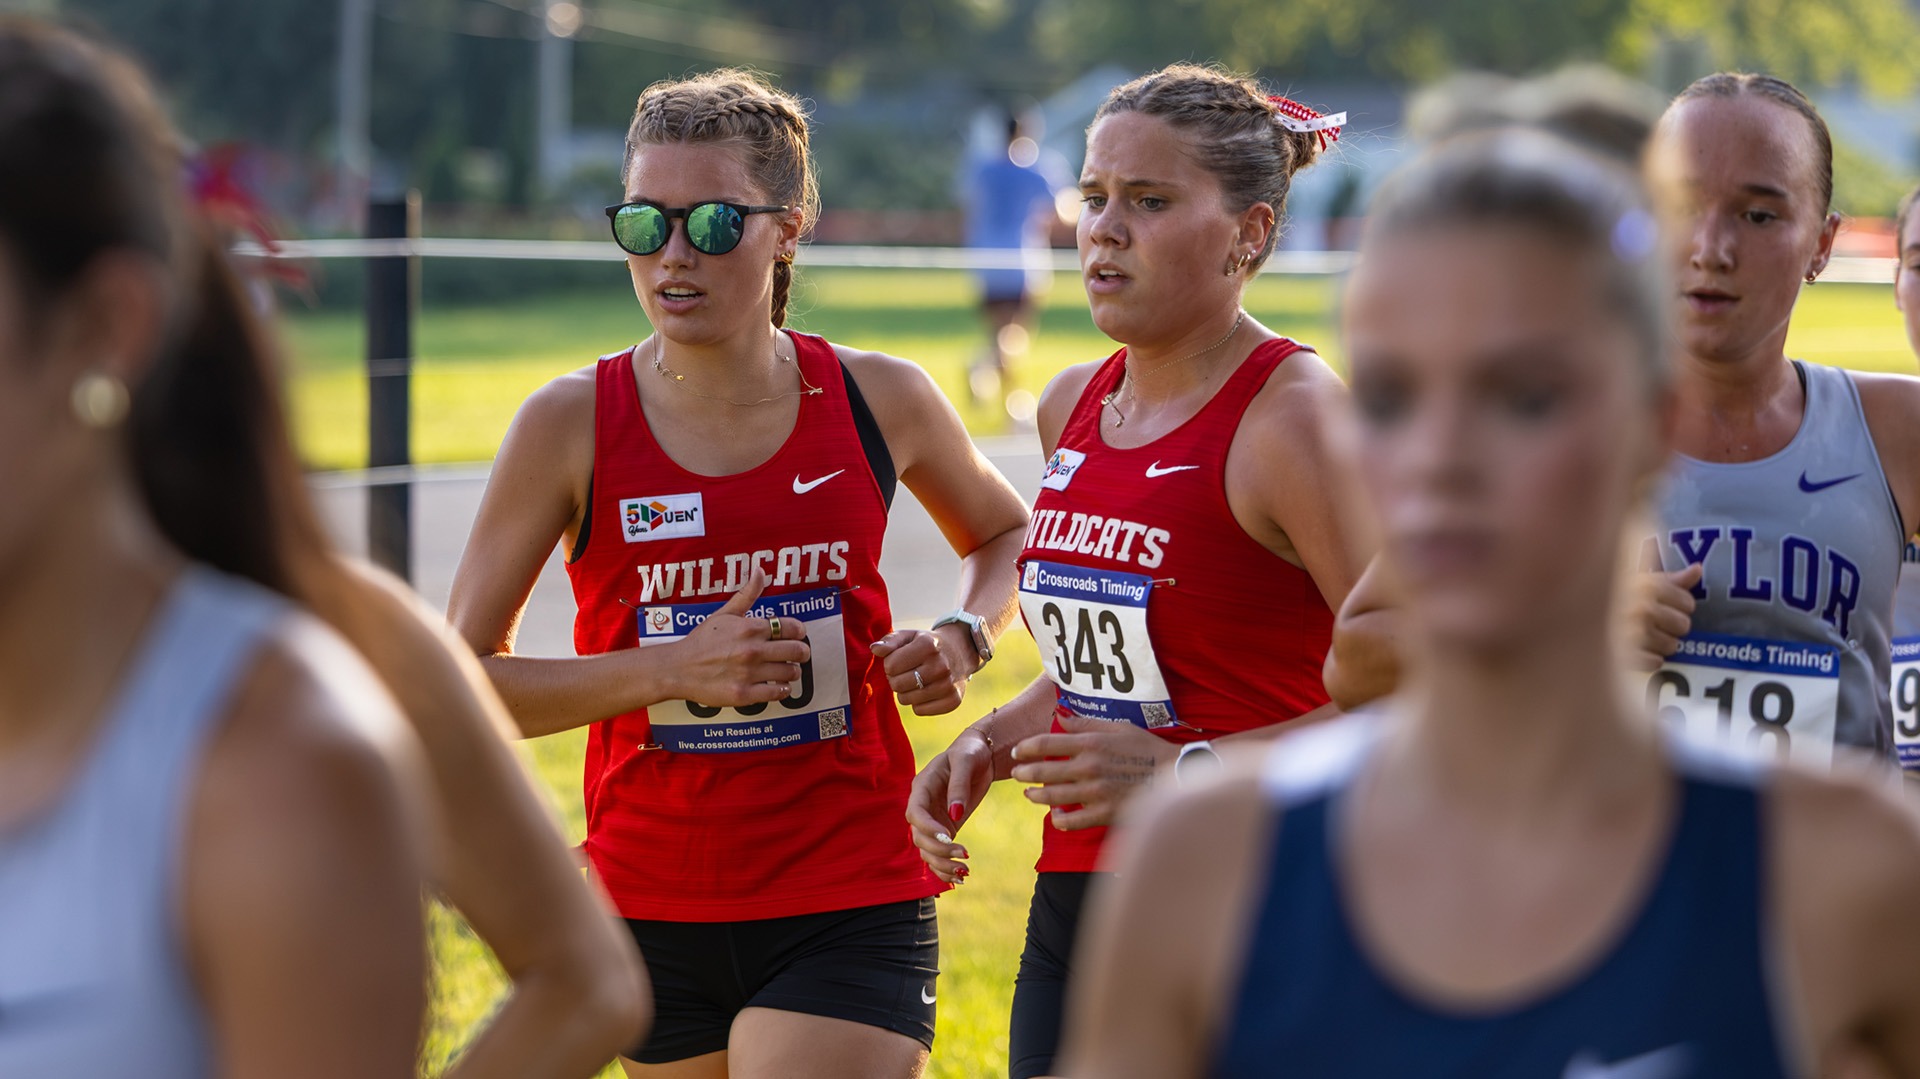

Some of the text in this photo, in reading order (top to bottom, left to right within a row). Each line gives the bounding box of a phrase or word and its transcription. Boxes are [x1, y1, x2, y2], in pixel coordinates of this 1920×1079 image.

[637, 540, 849, 602] WILDCATS
[1038, 569, 1145, 601] Crossroads Timing
[1639, 527, 1861, 640] AYLOR
[676, 594, 836, 627] Croads Timing
[1042, 602, 1134, 693] 343
[1676, 639, 1833, 672] ossroads Timing
[1078, 699, 1099, 711] Results
[1100, 704, 1107, 712] at
[1646, 671, 1794, 757] 618
[678, 733, 801, 749] live.crossroadstiming.com
[704, 725, 773, 738] Live Results at
